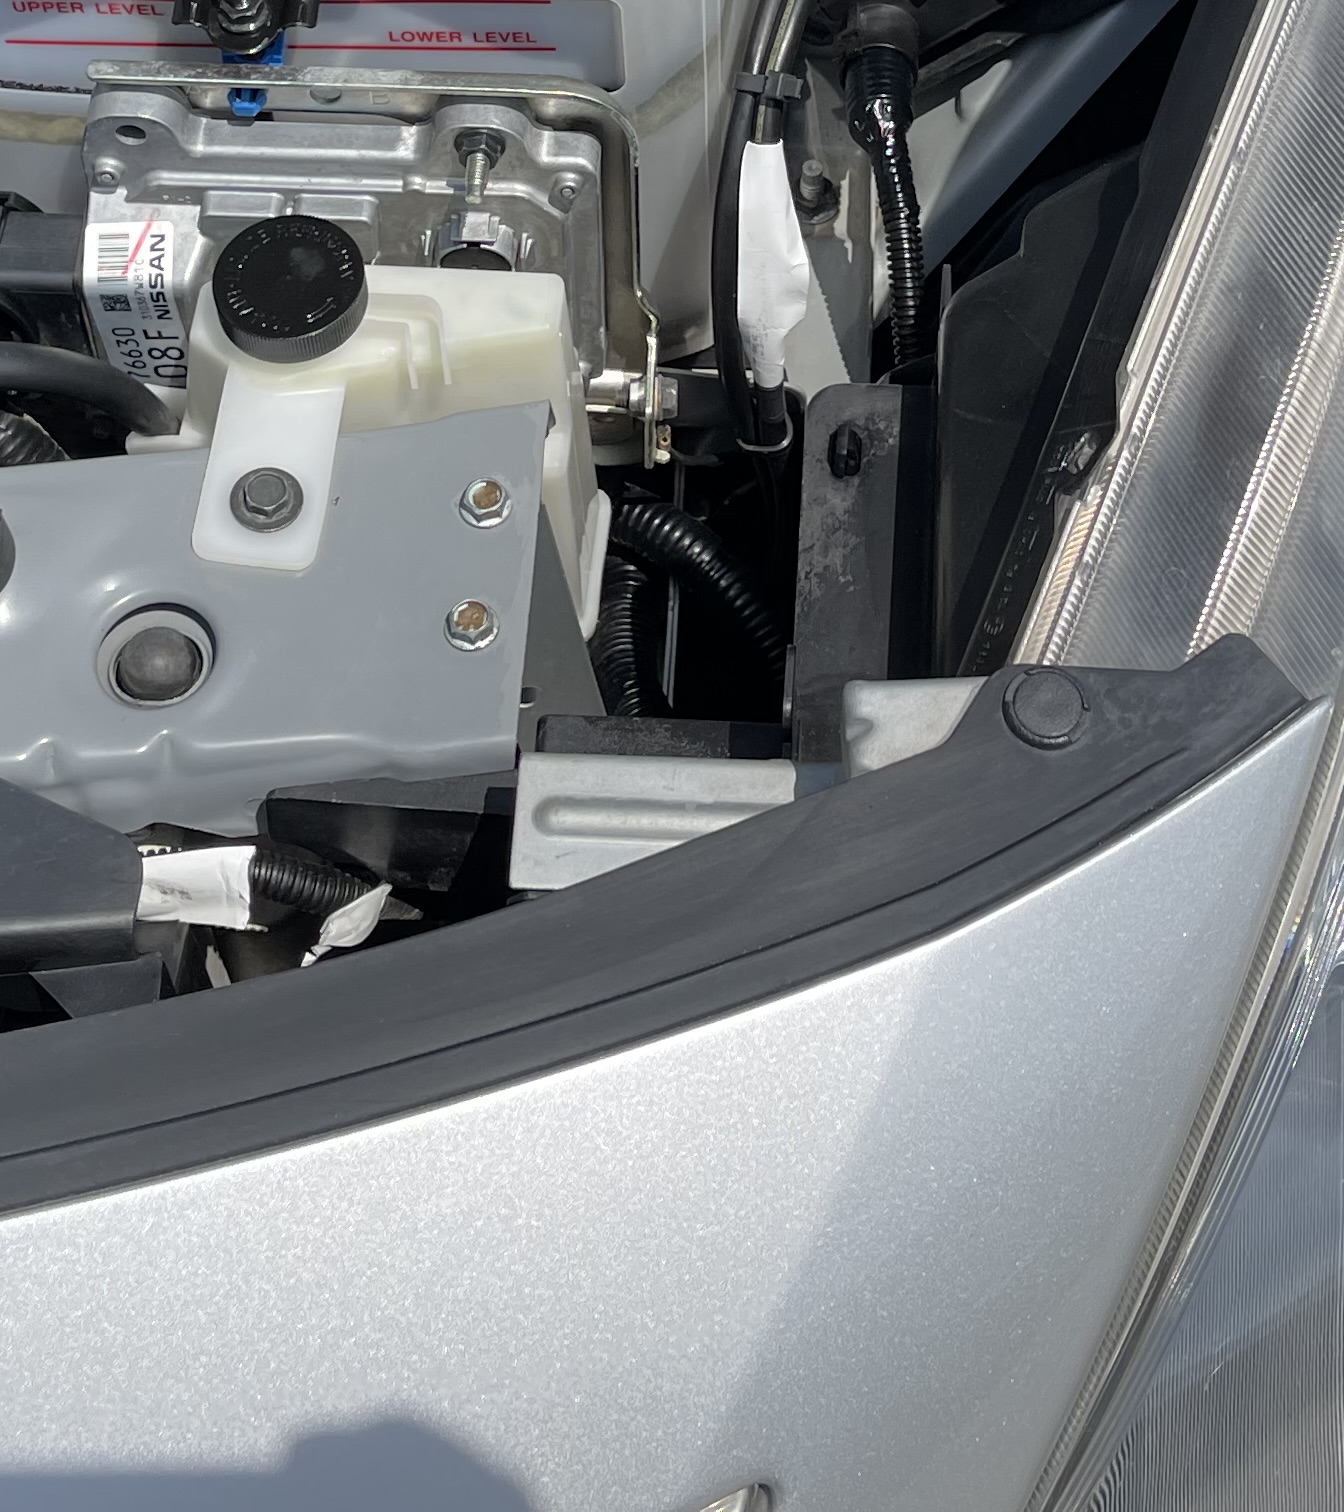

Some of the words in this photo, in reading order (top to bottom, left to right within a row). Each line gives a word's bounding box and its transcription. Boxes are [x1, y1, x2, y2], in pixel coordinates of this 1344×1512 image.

[12, 0, 85, 14] UPPER
[95, 2, 165, 16] LEVEL
[387, 30, 465, 44] LOWER
[471, 31, 538, 45] LEVEL
[148, 233, 173, 320] NISSAN
